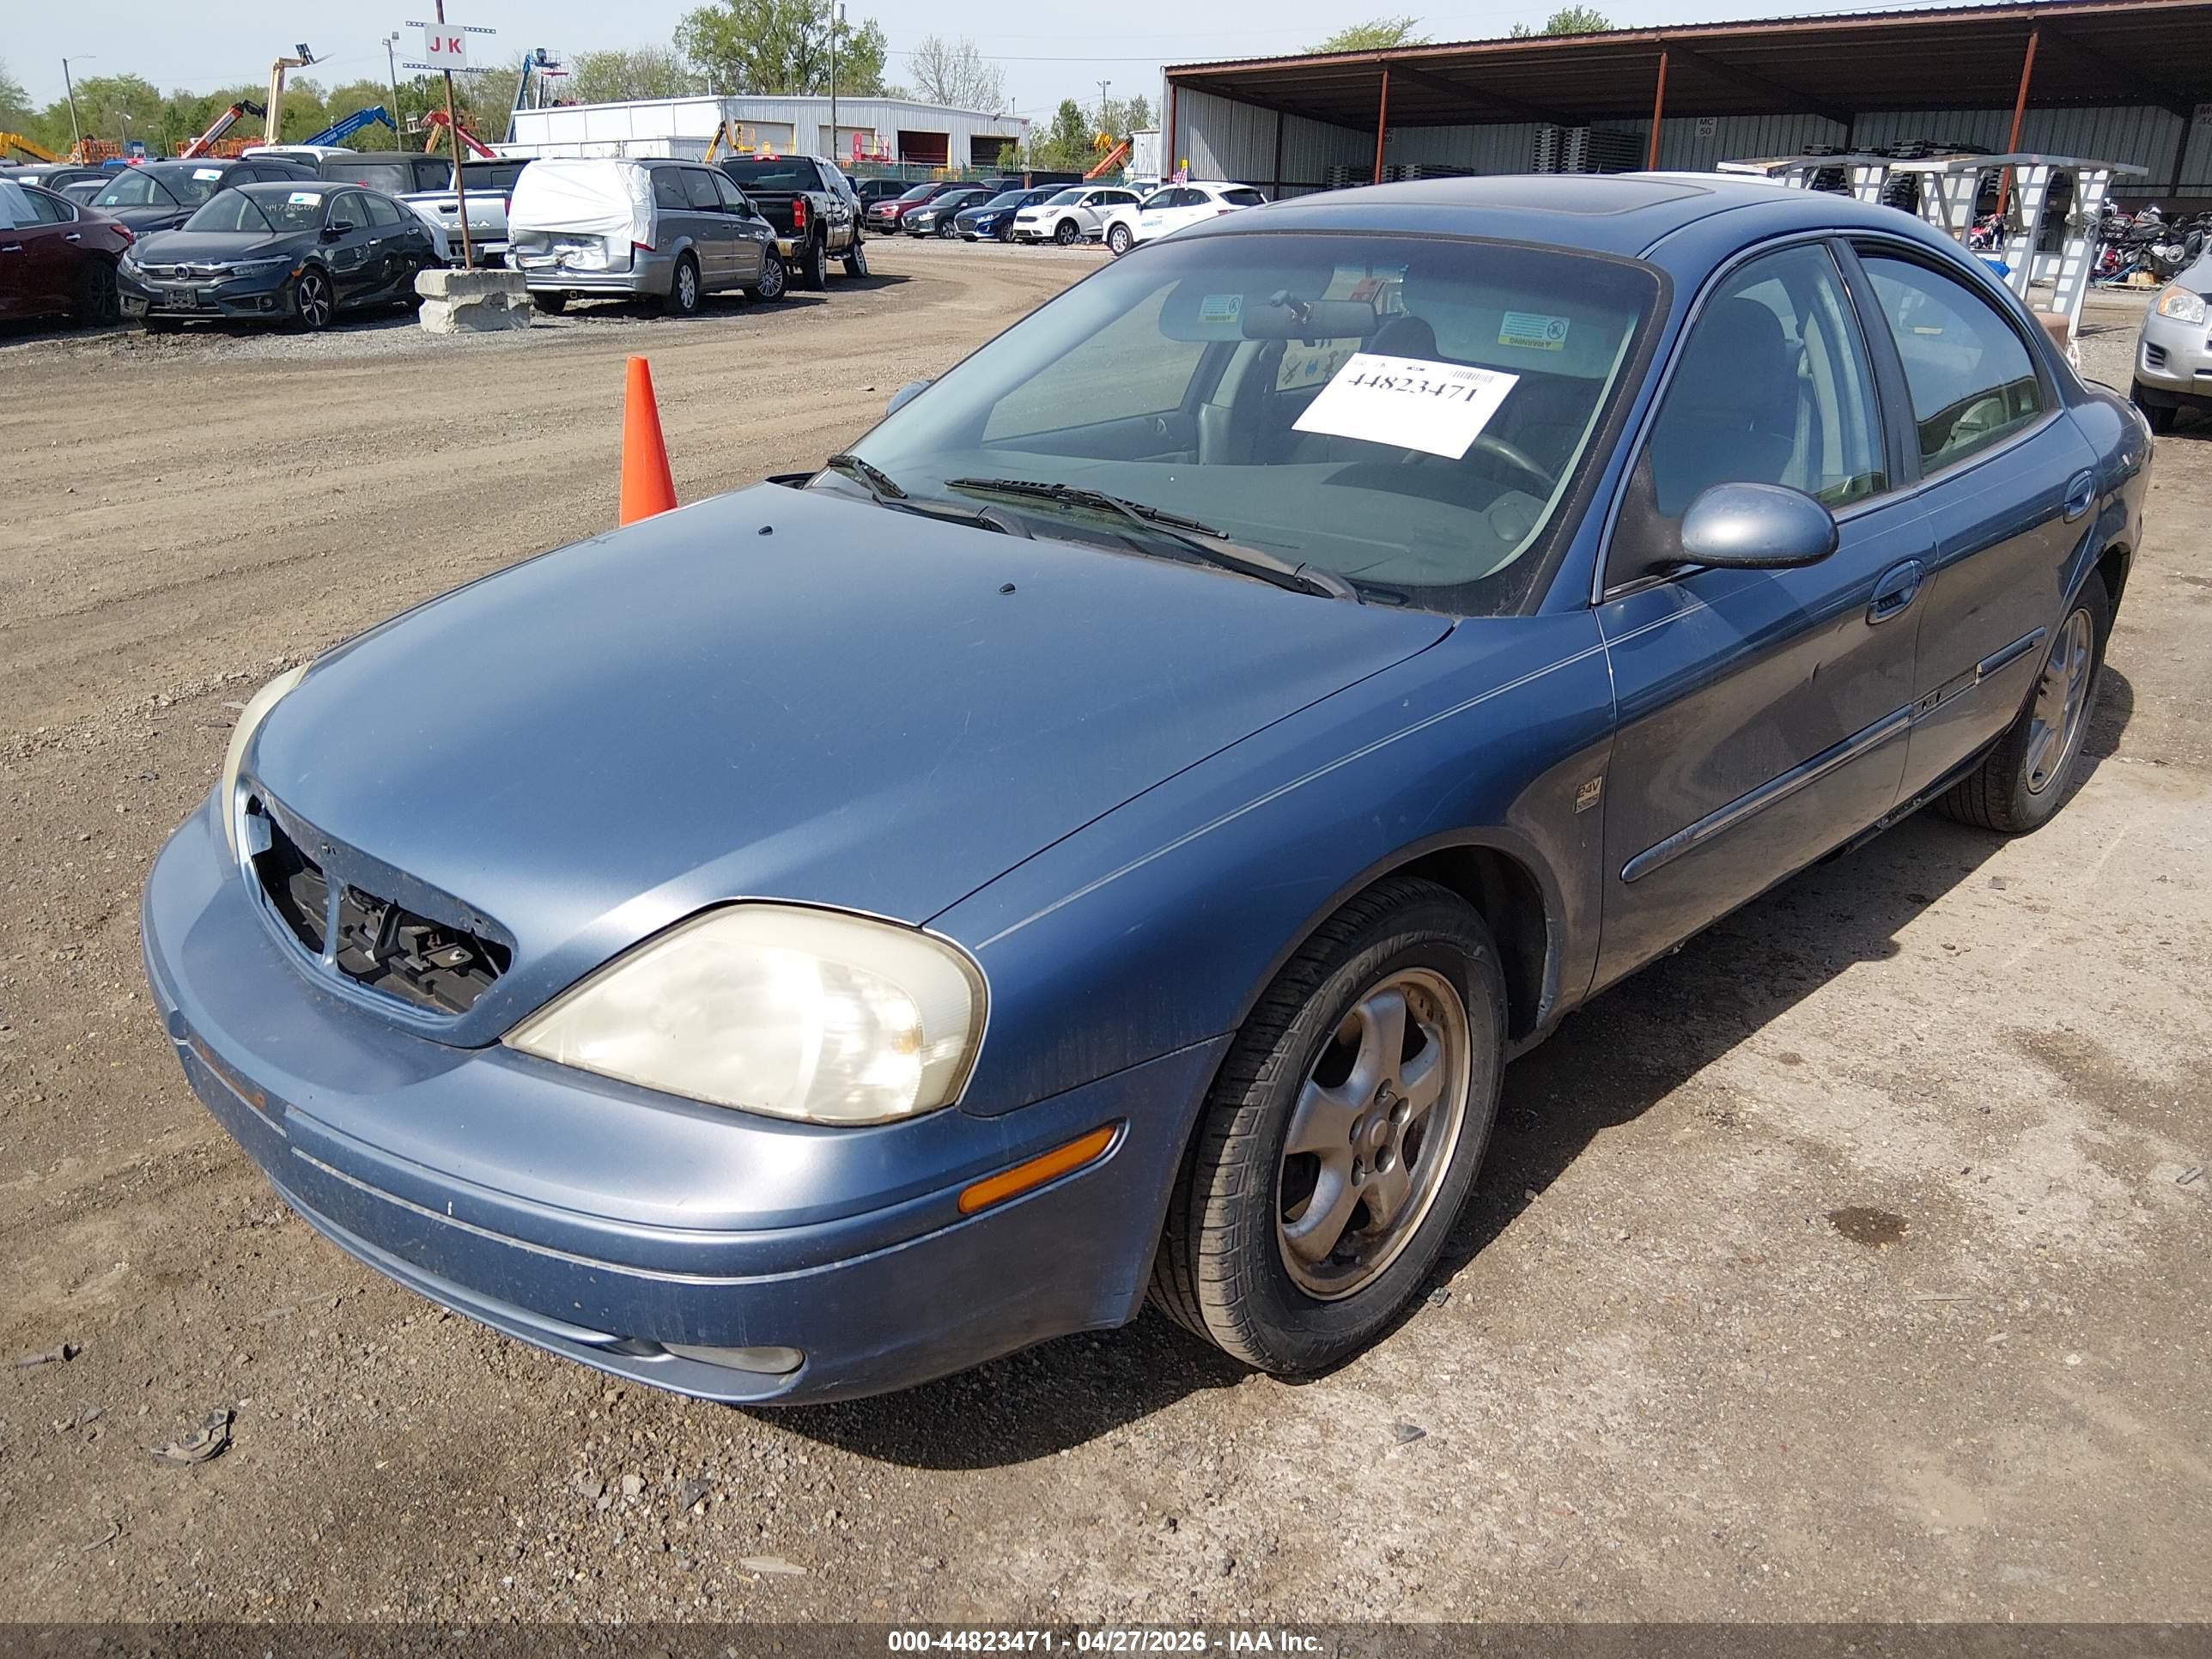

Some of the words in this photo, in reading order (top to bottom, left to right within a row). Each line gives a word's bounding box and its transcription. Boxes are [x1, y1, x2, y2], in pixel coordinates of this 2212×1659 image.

[429, 36, 441, 52] J
[448, 37, 462, 54] K
[1347, 373, 1478, 403] 44823471
